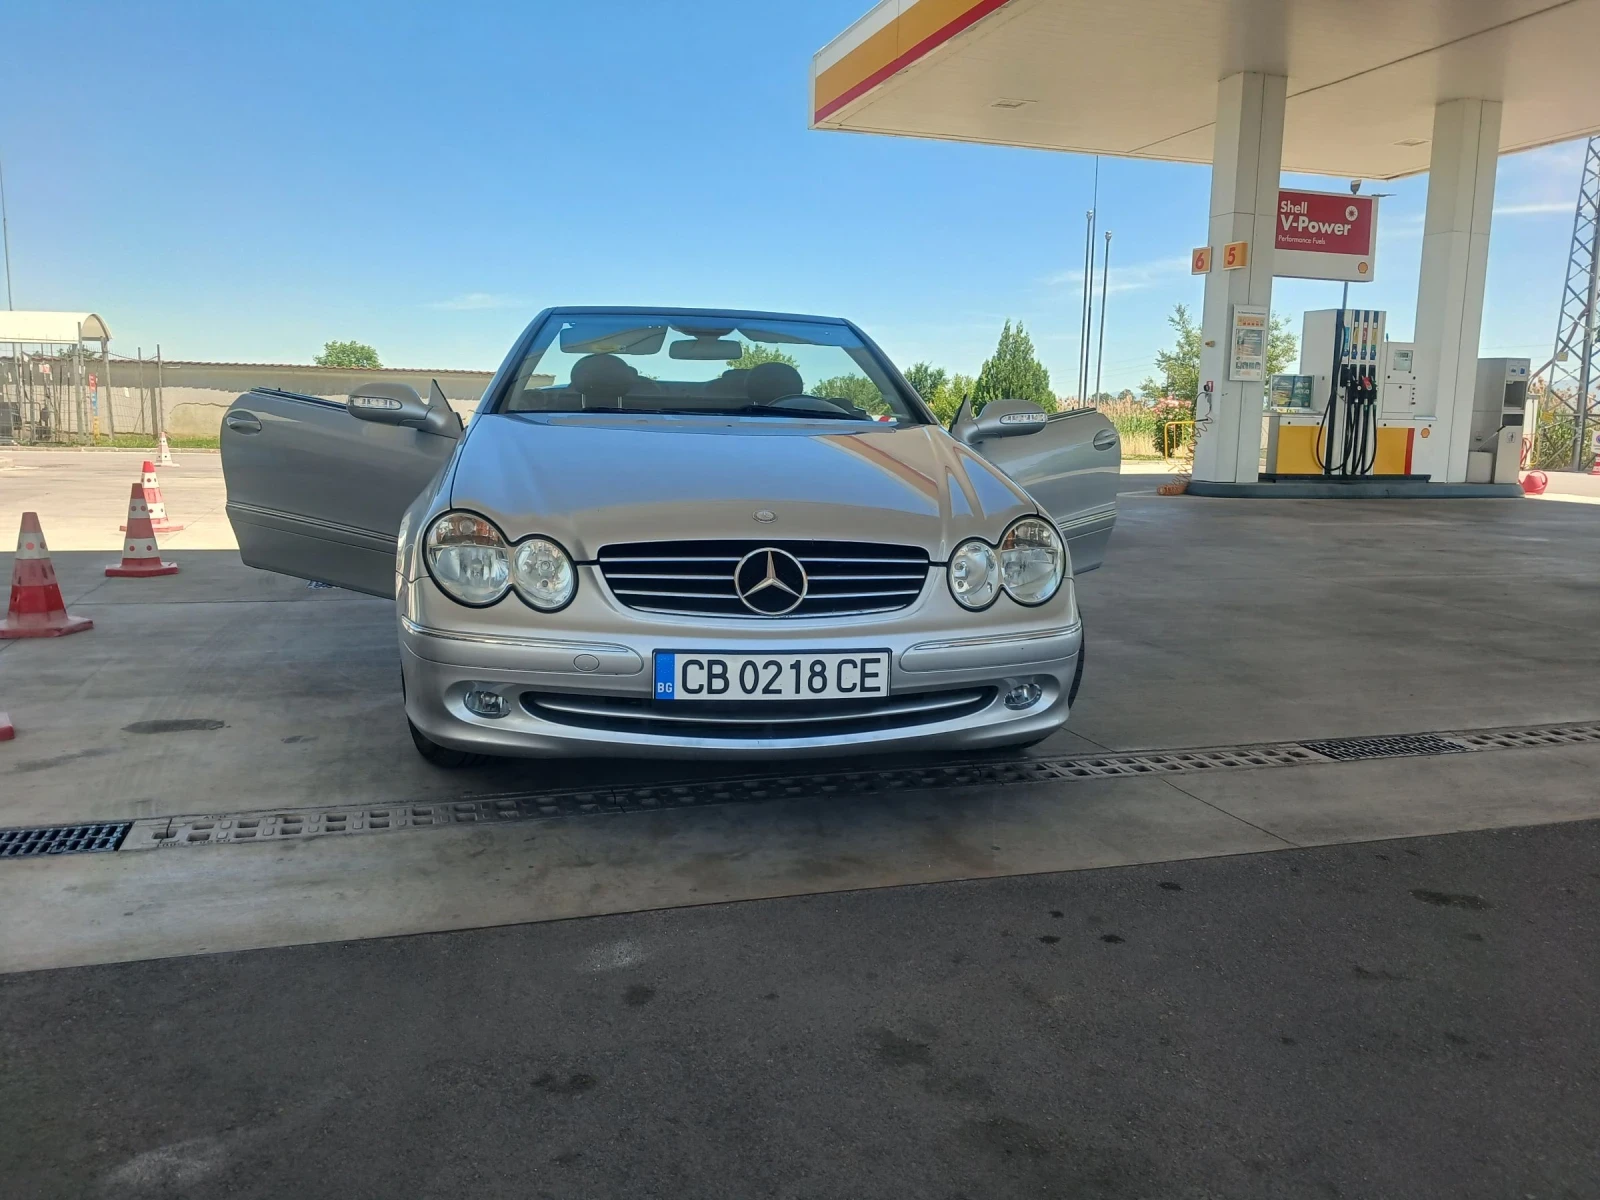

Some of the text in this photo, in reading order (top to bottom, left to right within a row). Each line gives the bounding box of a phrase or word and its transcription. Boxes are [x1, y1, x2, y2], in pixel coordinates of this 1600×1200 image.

[1280, 200, 1308, 214] Shell
[1280, 214, 1352, 236] V-Power
[1278, 234, 1326, 245] Performance Fuels
[1195, 252, 1205, 270] 6
[1227, 246, 1236, 265] 5
[681, 657, 881, 695] CB 0218 CE
[657, 682, 673, 693] BG
